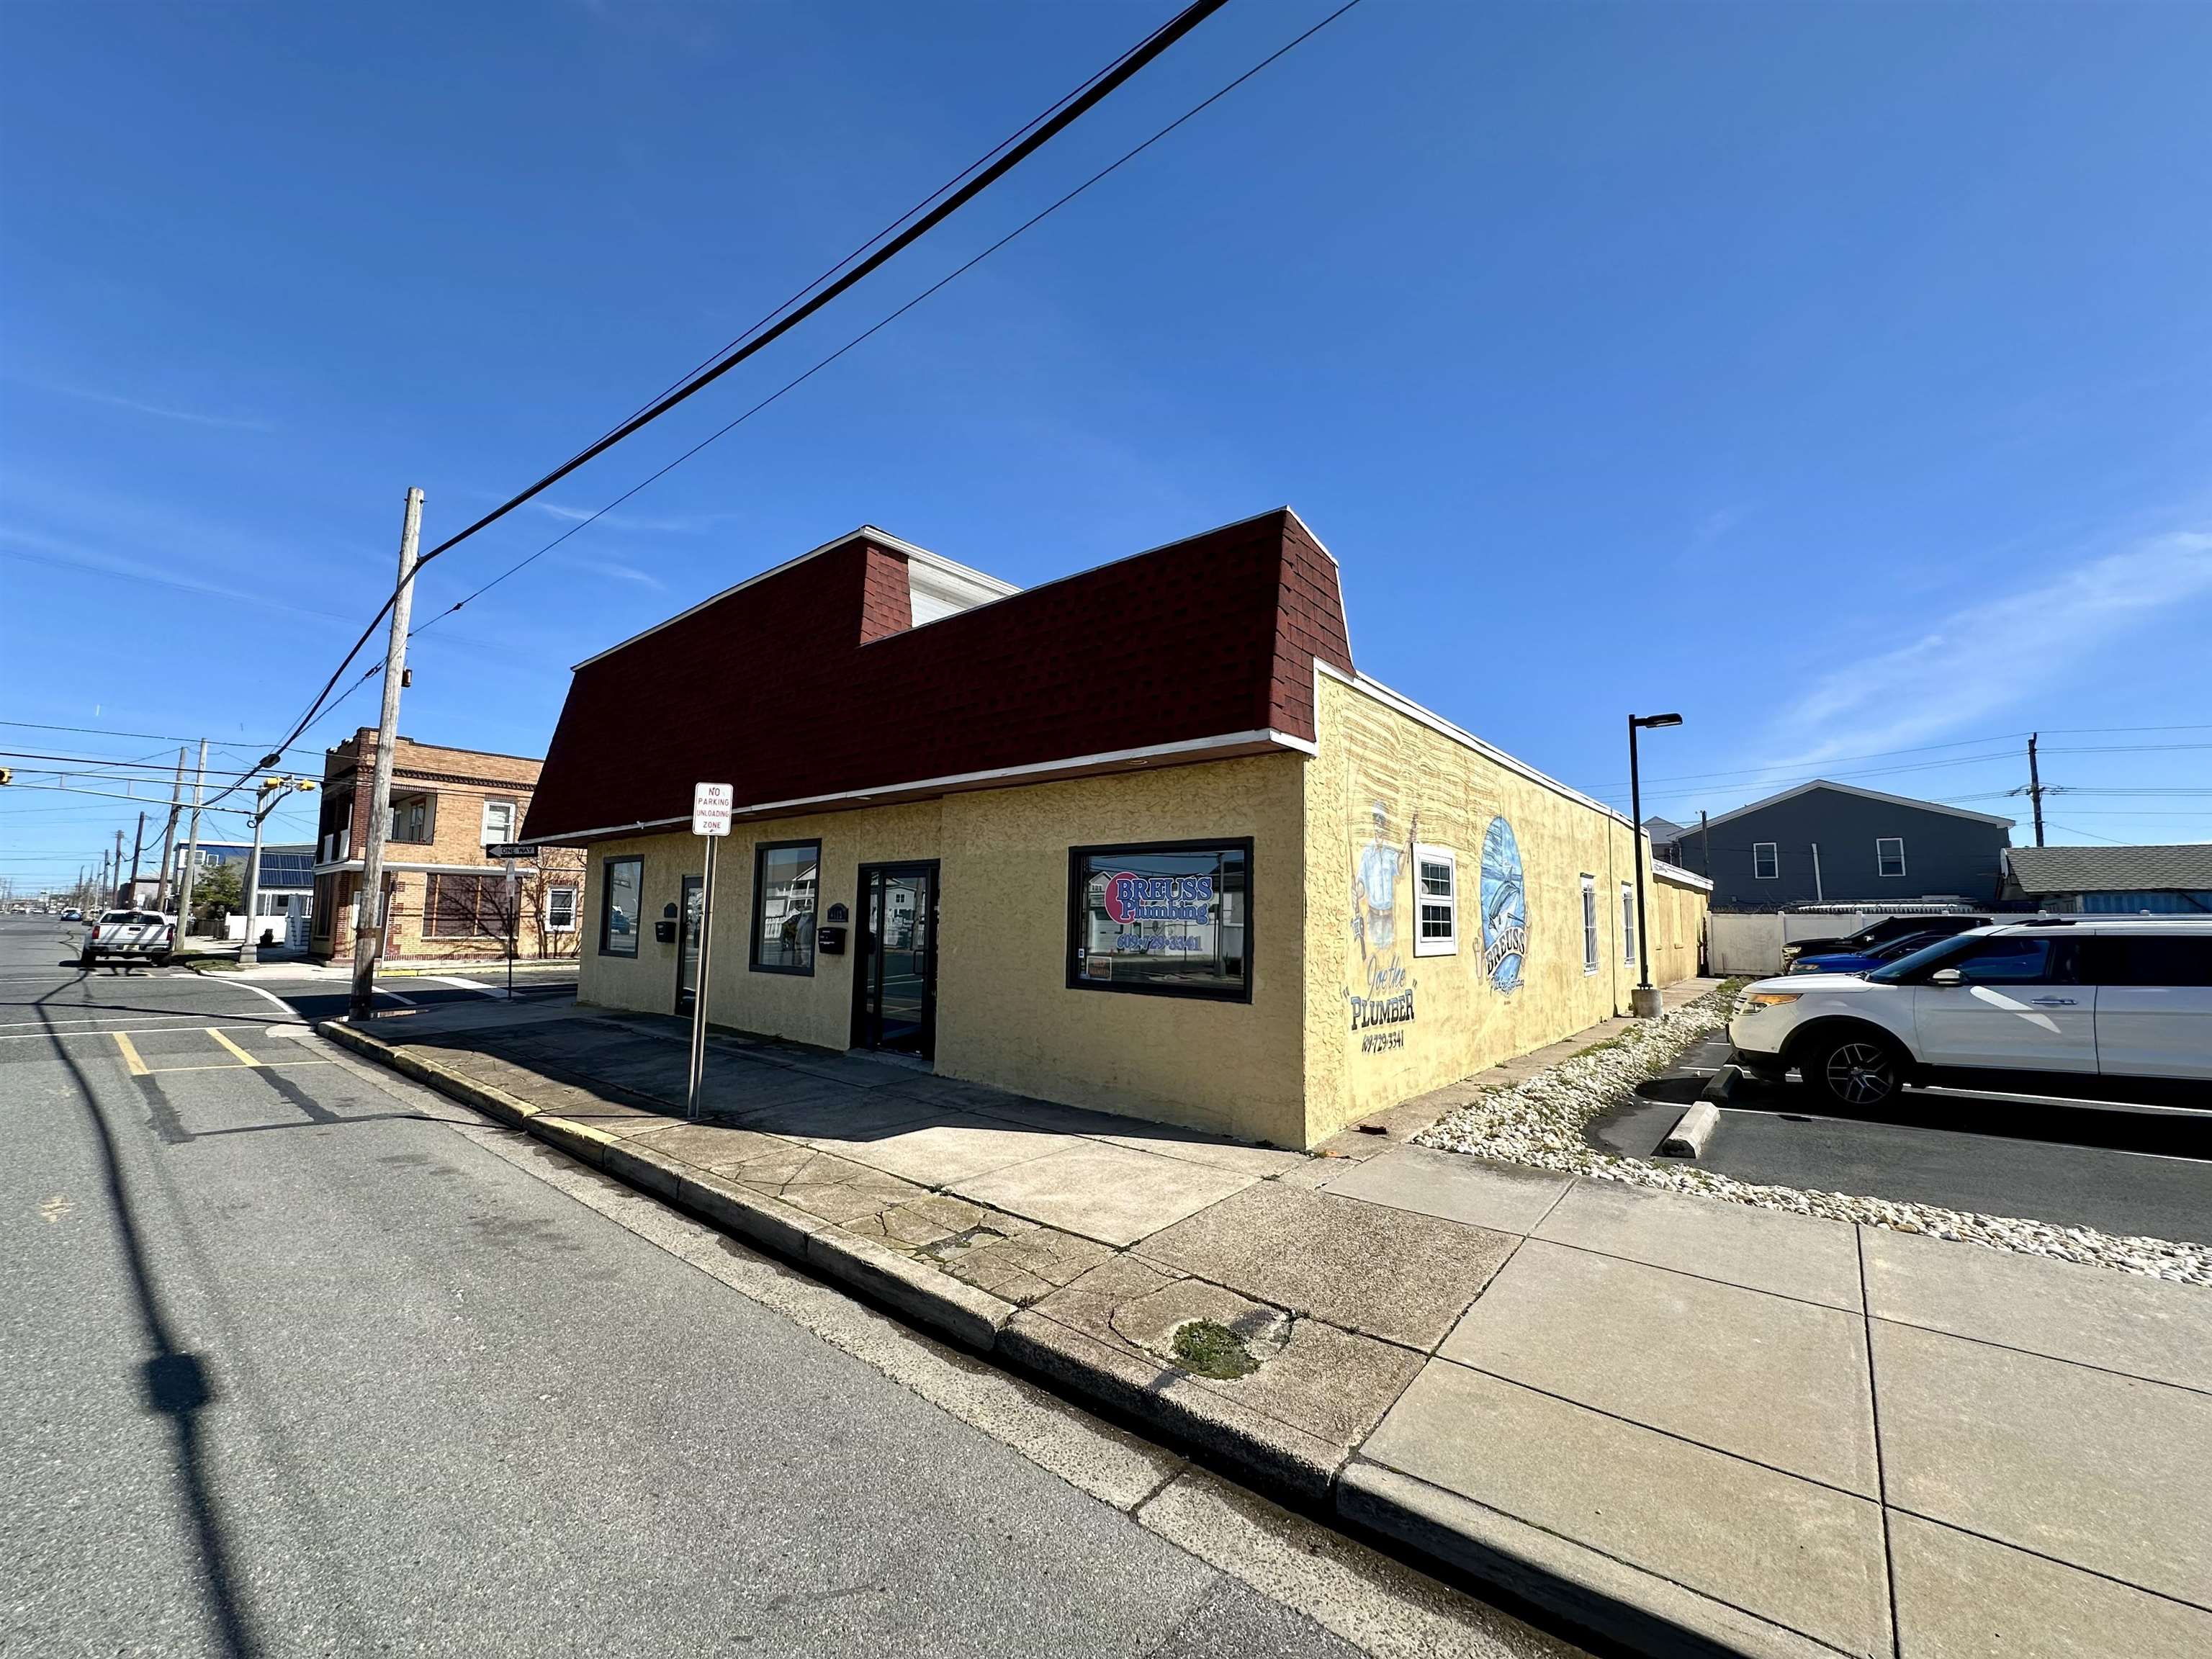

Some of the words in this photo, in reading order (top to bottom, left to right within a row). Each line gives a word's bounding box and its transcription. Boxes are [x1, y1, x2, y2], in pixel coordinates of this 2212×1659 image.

[709, 788, 720, 796] NO
[1117, 878, 1213, 901] BREUSS
[1121, 899, 1208, 924] Plumbing
[1486, 928, 1525, 976] BREUSS
